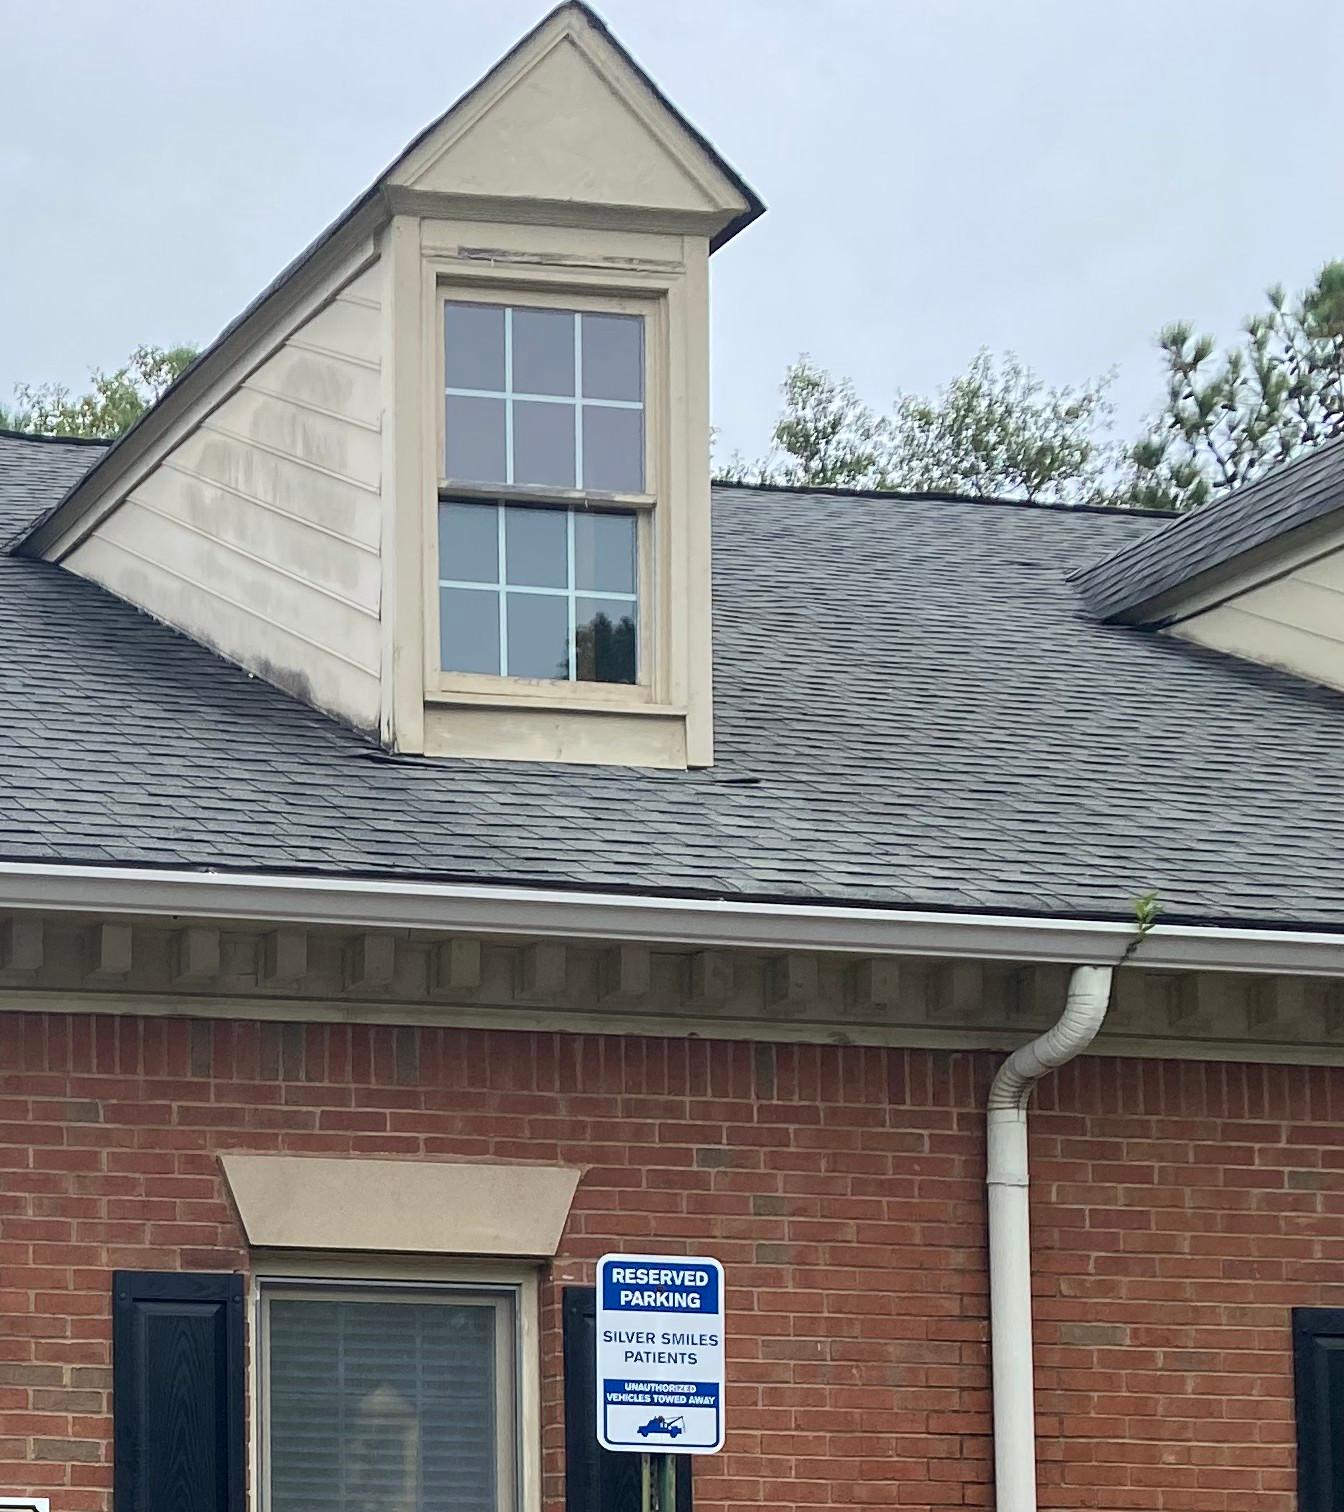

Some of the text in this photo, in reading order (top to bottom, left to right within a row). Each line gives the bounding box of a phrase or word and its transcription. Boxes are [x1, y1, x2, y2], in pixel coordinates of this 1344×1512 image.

[612, 1268, 708, 1286] RESERVED
[621, 1291, 701, 1308] PARKING
[603, 1331, 718, 1346] SILVER SMILES
[625, 1351, 697, 1365] PATIENTS
[625, 1383, 696, 1393] UNAUTHORIZED
[607, 1393, 715, 1405] VEHICLES TOWED AWAY
